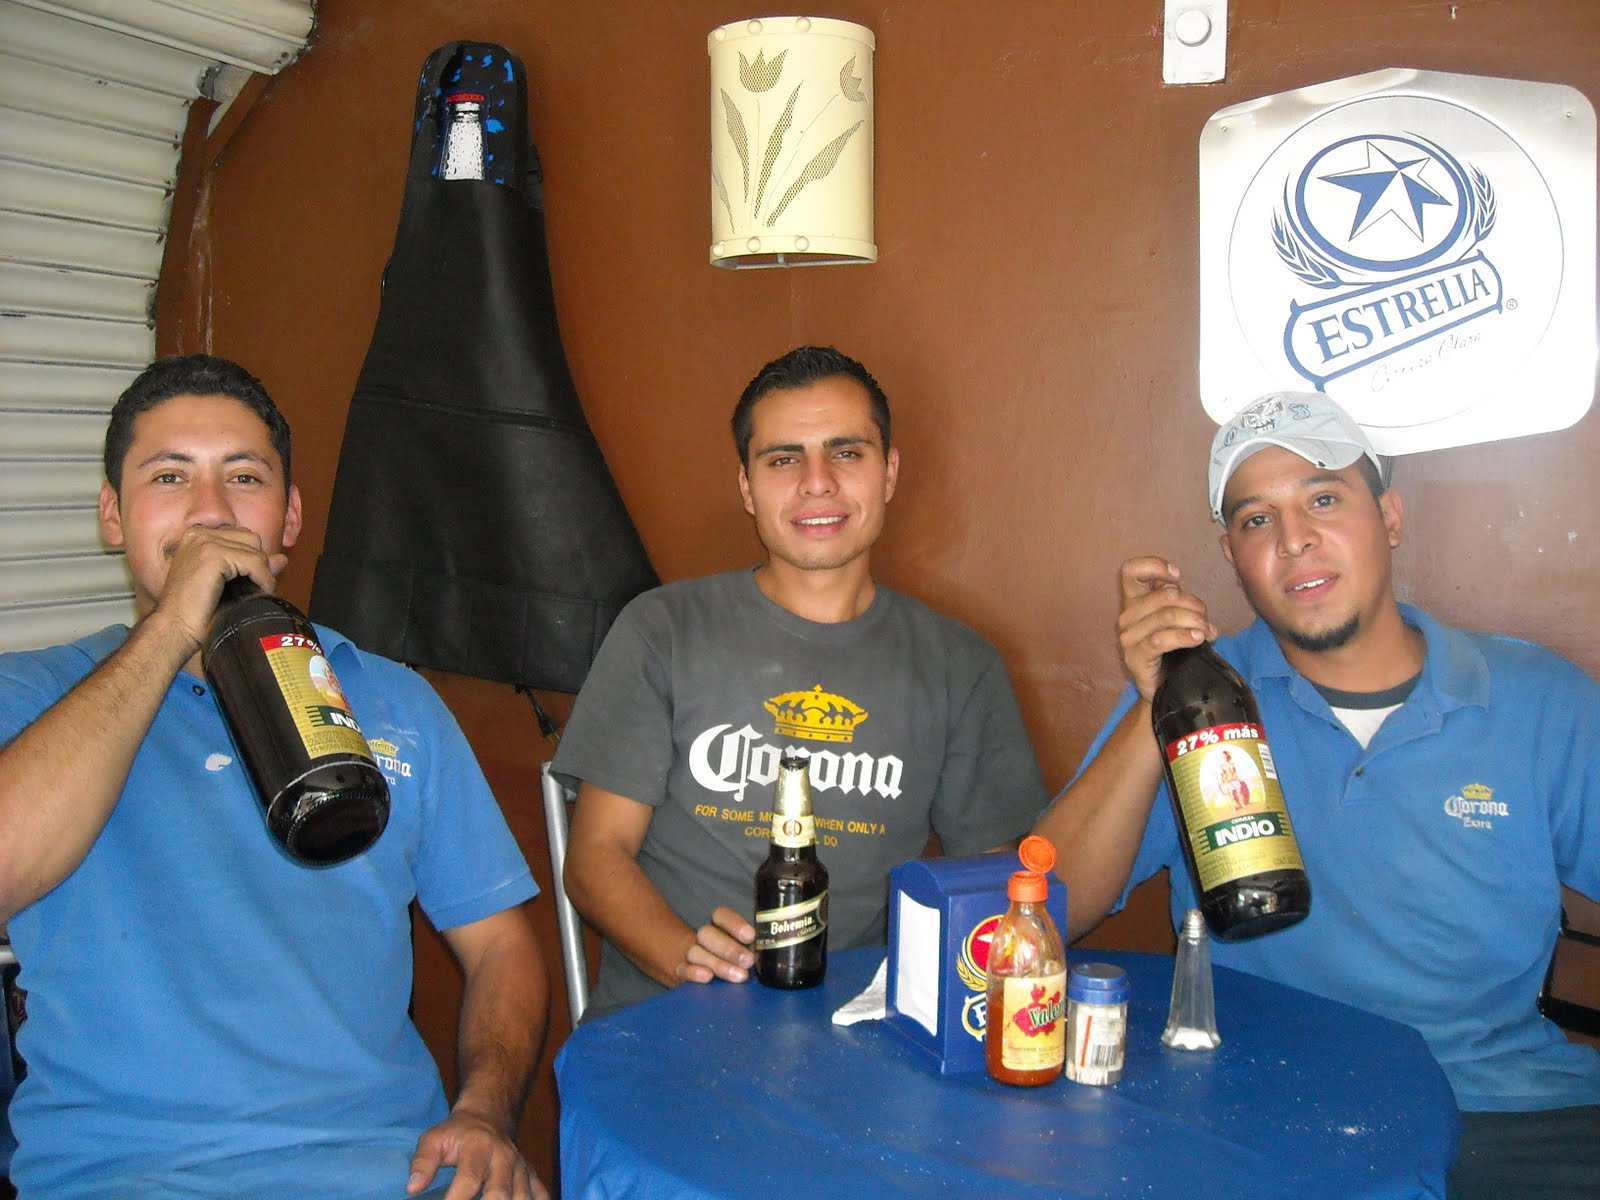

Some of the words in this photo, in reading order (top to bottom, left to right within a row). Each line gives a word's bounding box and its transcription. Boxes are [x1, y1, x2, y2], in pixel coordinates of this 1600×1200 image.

[1307, 268, 1491, 364] ESTRELLA
[330, 712, 362, 734] IND
[1177, 730, 1219, 757] 27%
[1223, 725, 1259, 741] más
[372, 753, 411, 778] rona
[695, 804, 717, 818] FOR
[721, 808, 754, 823] SOME
[815, 816, 844, 831] WHEN
[848, 821, 877, 835] ONLY
[1444, 795, 1509, 819] Corona
[745, 827, 770, 839] COR
[1214, 819, 1275, 847] INDIO
[770, 916, 813, 935] Bohemia
